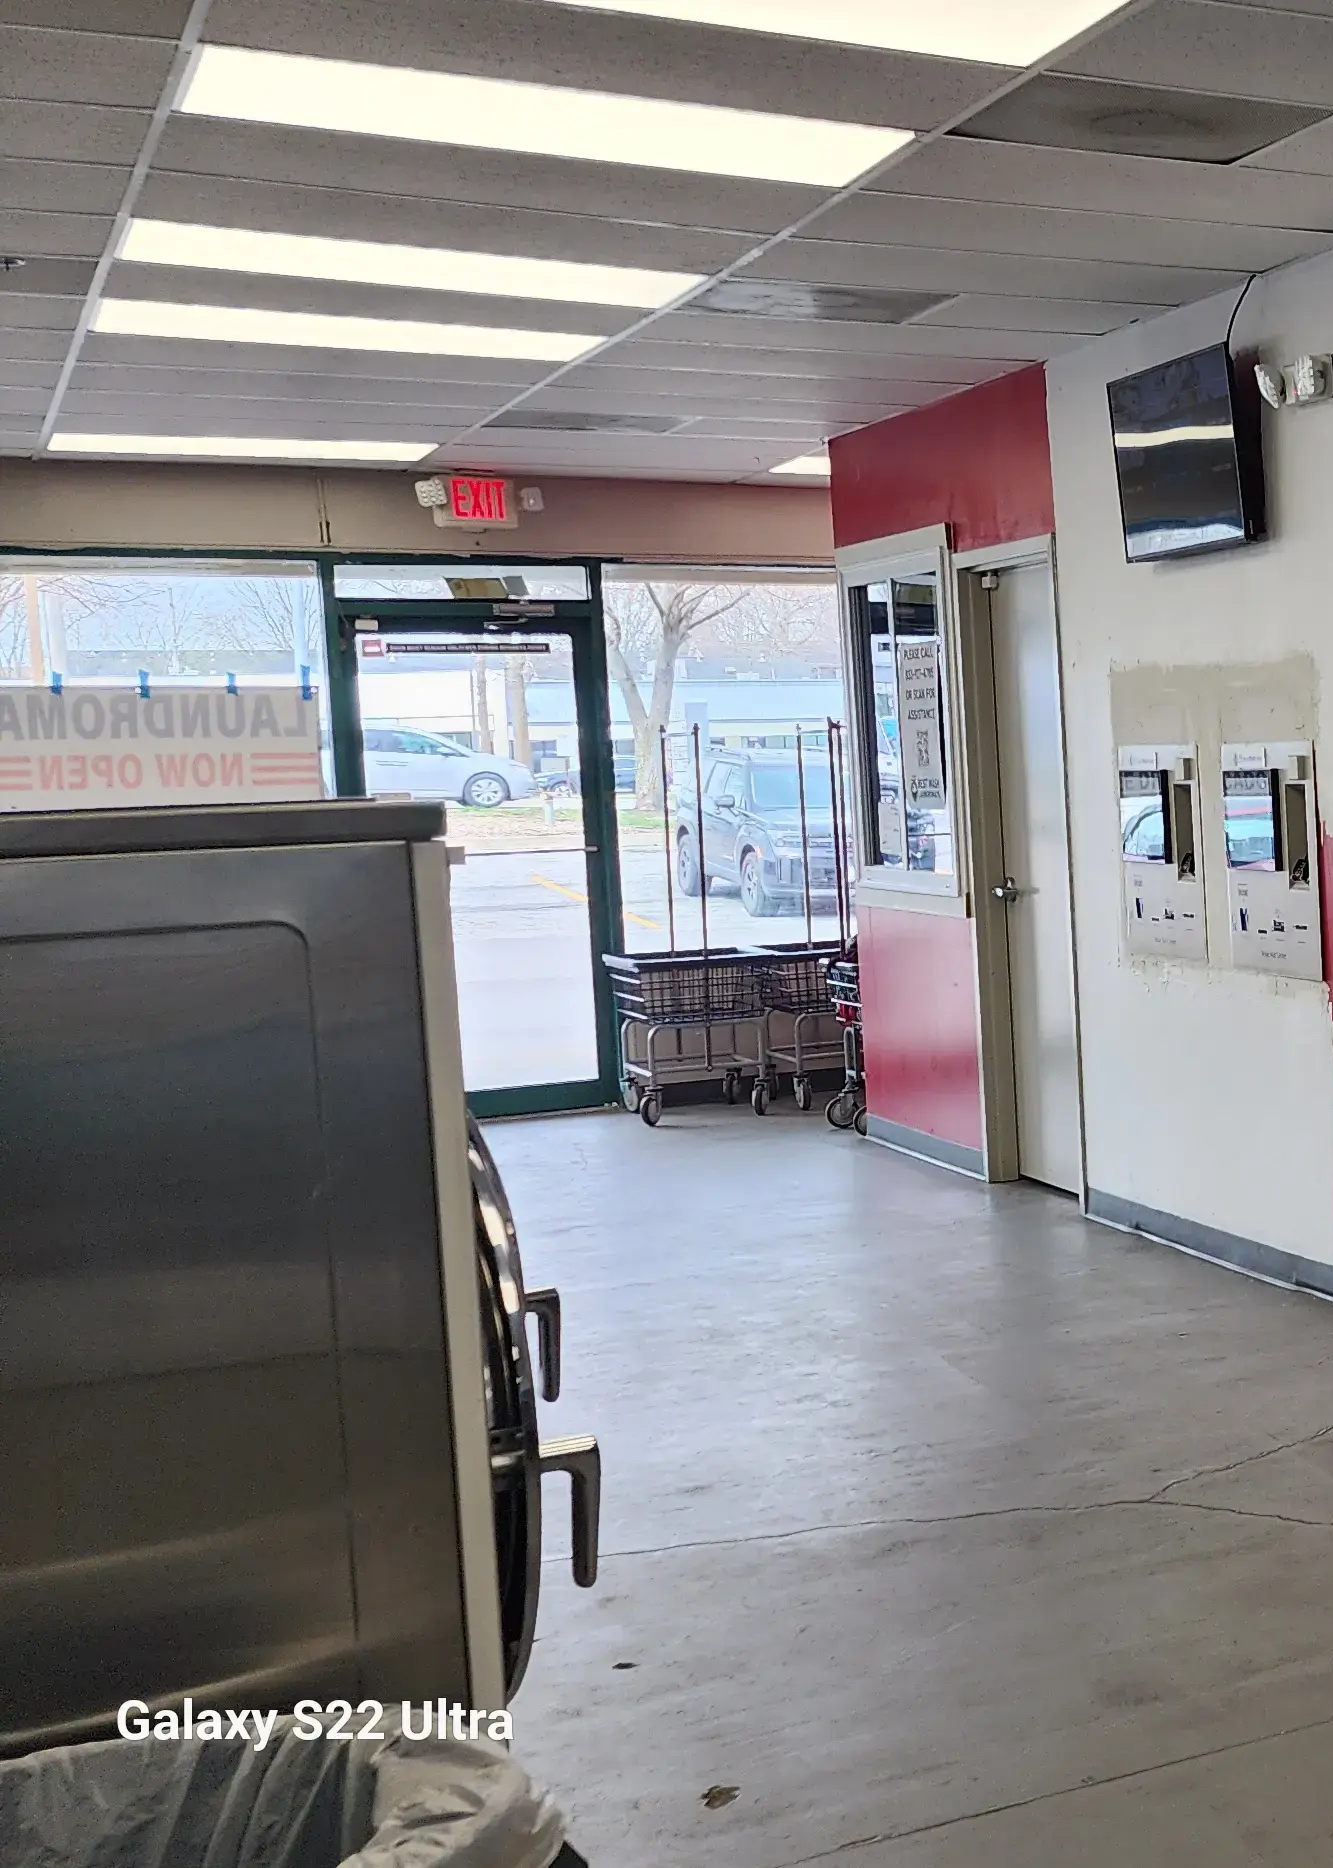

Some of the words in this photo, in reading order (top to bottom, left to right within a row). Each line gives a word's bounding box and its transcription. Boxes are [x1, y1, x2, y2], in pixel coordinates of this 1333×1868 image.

[450, 478, 505, 520] EXIT
[920, 646, 934, 659] CALL
[913, 688, 926, 700] SCAN
